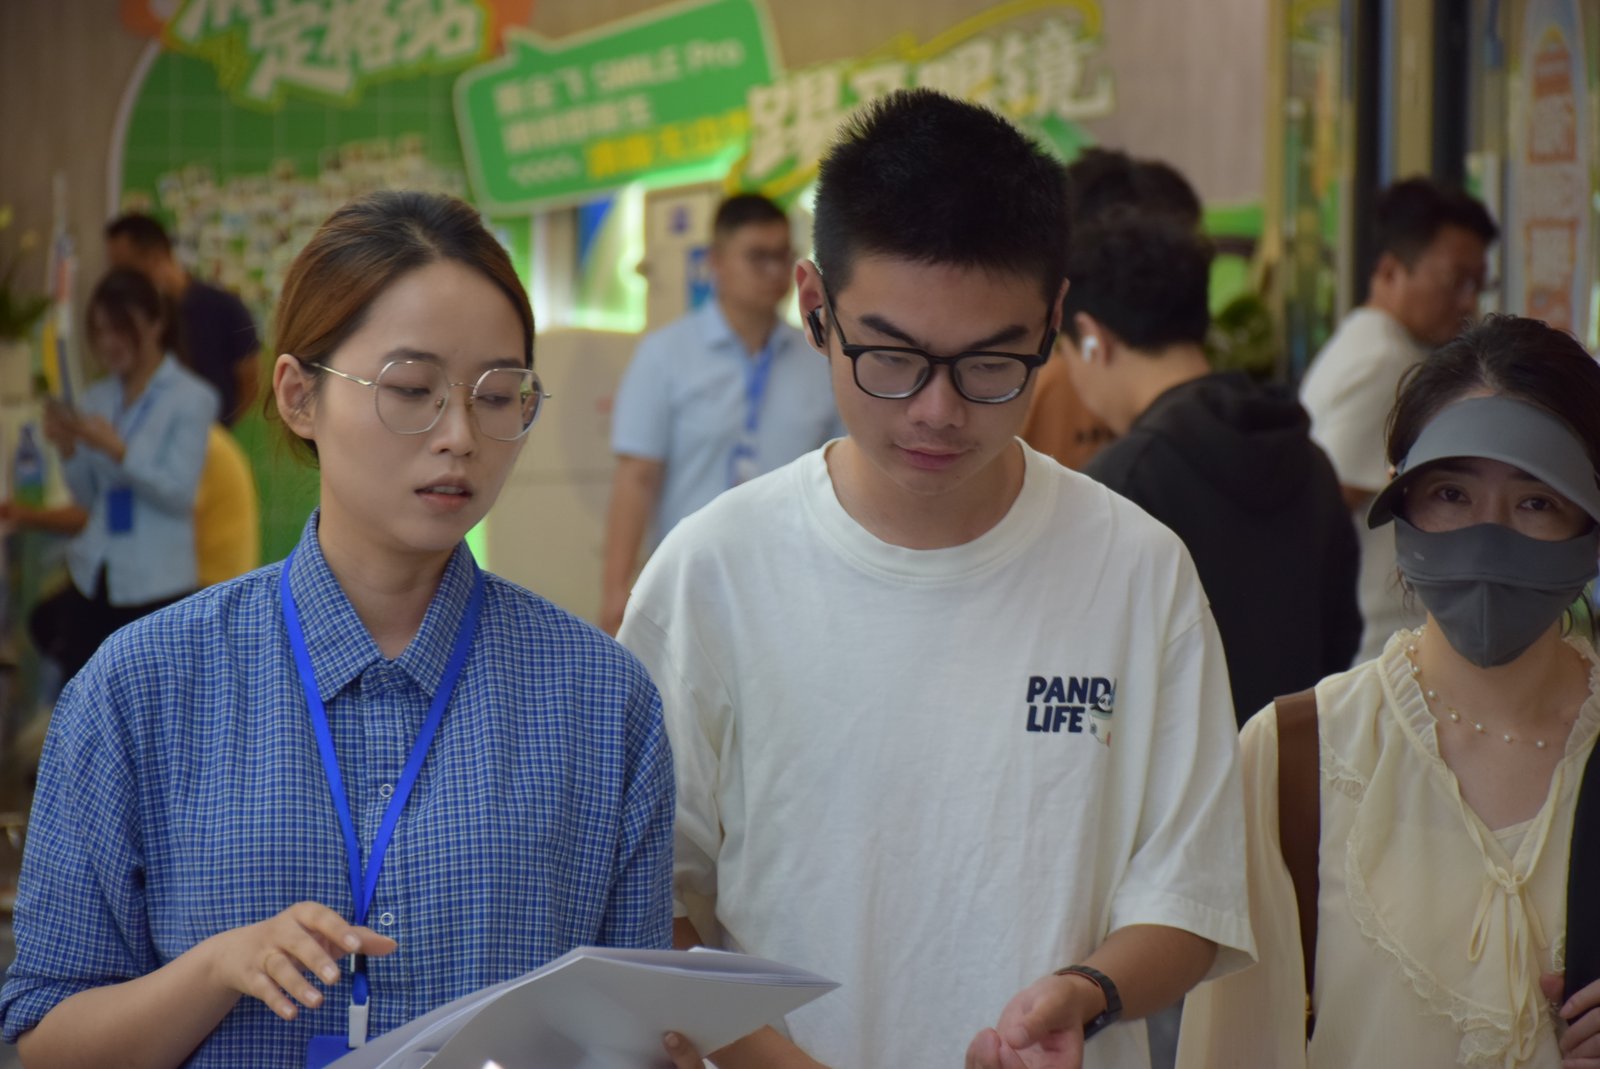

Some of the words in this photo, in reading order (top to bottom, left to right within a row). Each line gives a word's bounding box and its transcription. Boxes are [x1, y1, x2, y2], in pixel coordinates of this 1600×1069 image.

[592, 46, 681, 91] SMILE
[684, 38, 746, 71] Pro
[1026, 676, 1117, 704] PAND
[1026, 705, 1086, 733] LIFE
